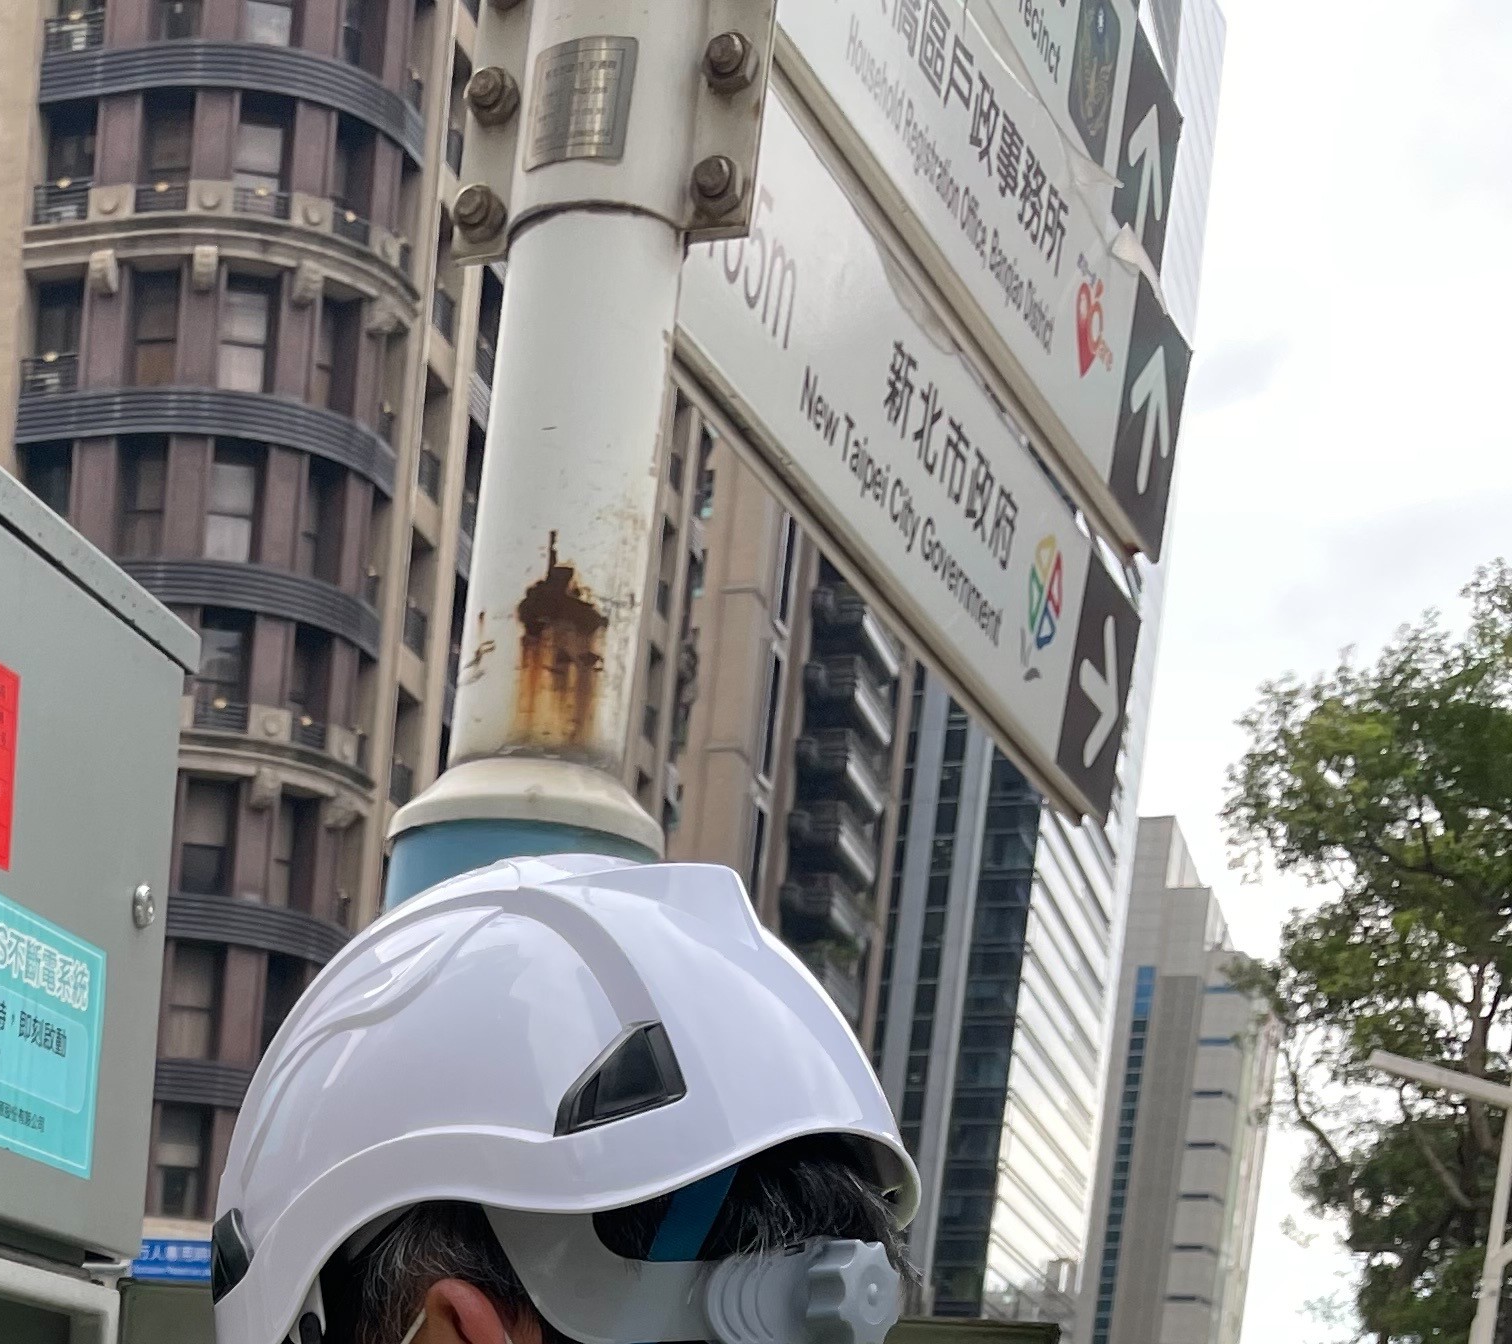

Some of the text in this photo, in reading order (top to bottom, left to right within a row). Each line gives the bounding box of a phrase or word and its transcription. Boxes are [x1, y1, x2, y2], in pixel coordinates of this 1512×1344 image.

[709, 185, 796, 350] 5m
[800, 365, 1004, 647] New Taipei City Government
[883, 341, 1019, 570] 新北市政府
